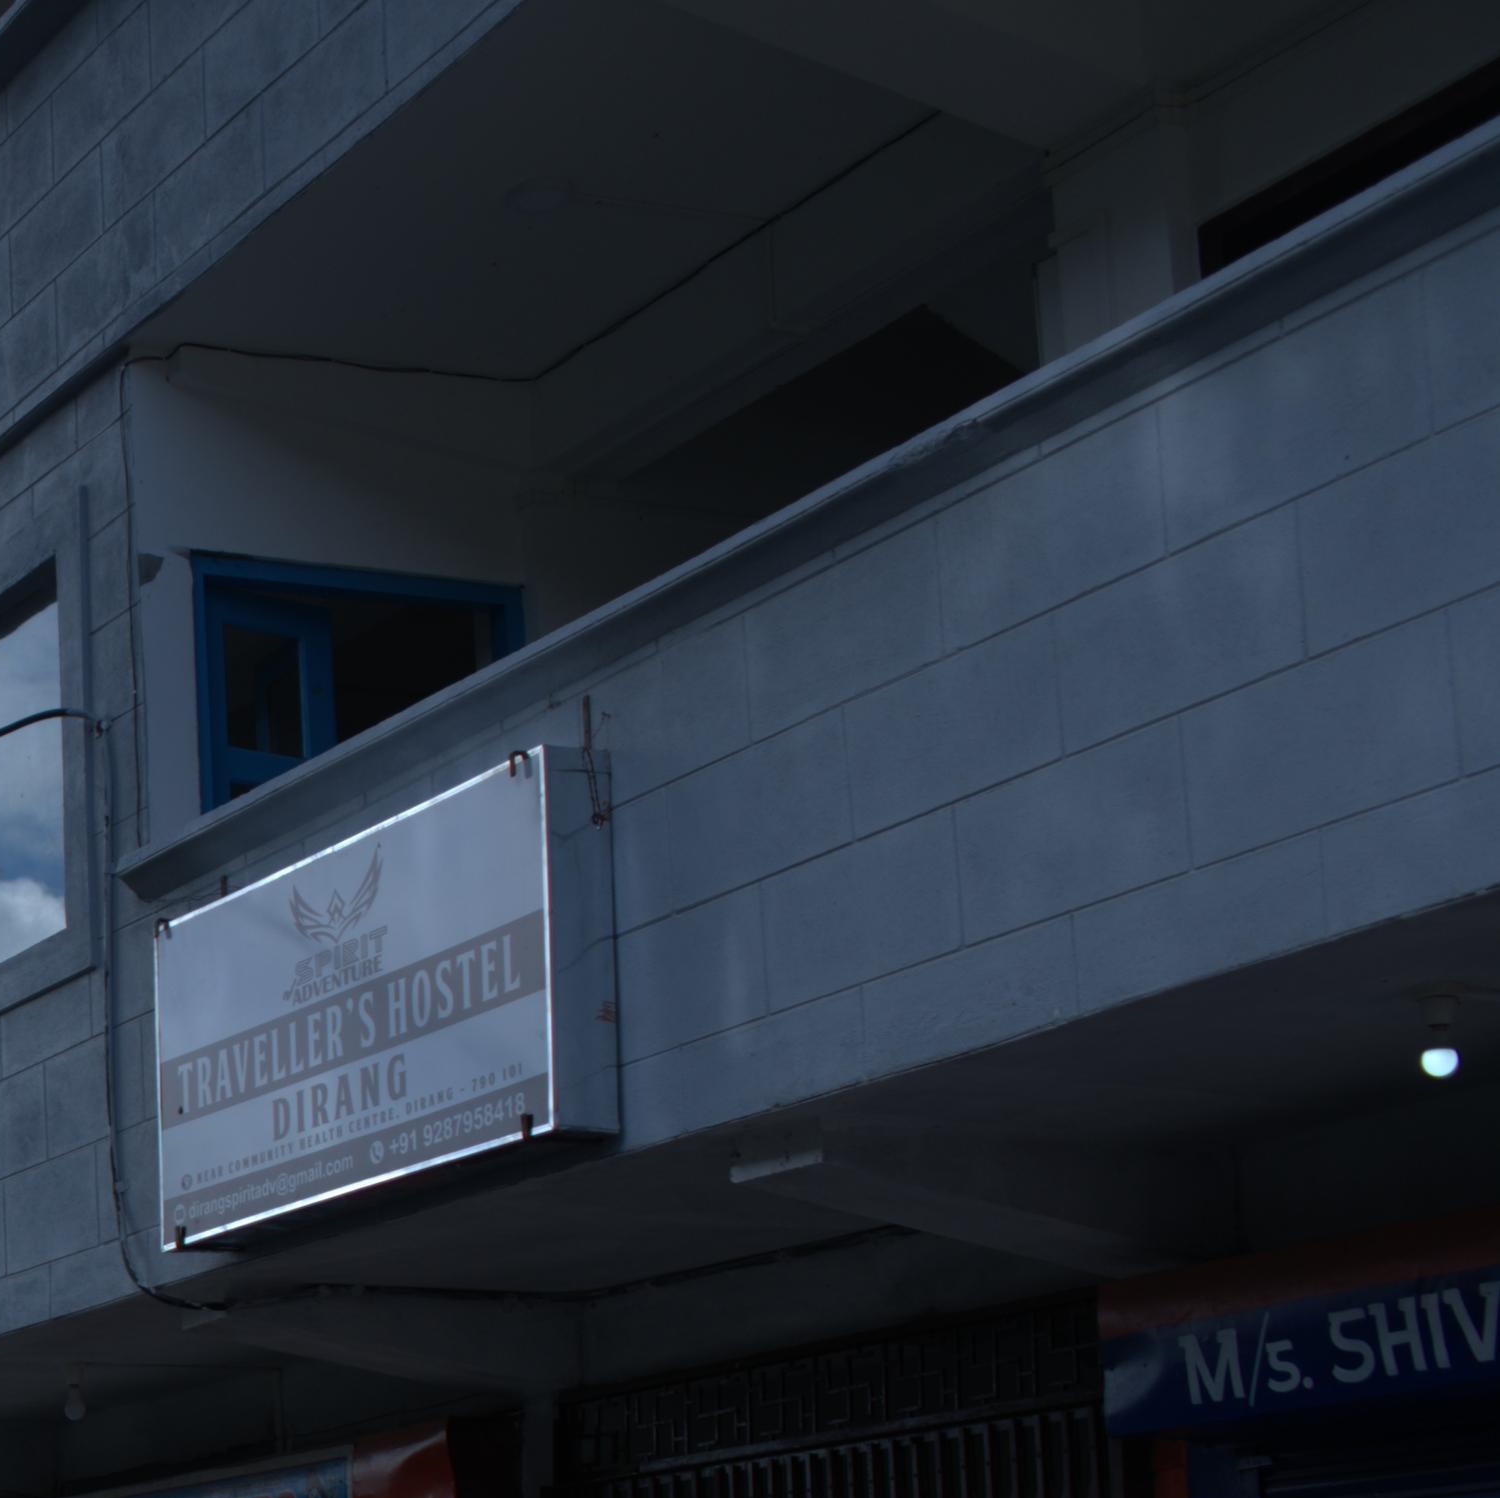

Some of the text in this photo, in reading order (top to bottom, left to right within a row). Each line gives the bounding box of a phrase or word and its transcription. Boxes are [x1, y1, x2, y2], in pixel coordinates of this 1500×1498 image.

[283, 953, 384, 1006] ADVENTURE
[294, 926, 388, 984] SPIRIT
[177, 934, 521, 1115] TRAVELLER'S HOSTEL
[228, 1141, 294, 1173] COMMUNITY
[300, 1126, 344, 1151] HEALTH
[405, 1087, 454, 1116] DIRANG
[272, 1053, 408, 1141] DIRANG
[388, 1128, 418, 1157] +91
[1327, 1280, 1500, 1384] SHIV
